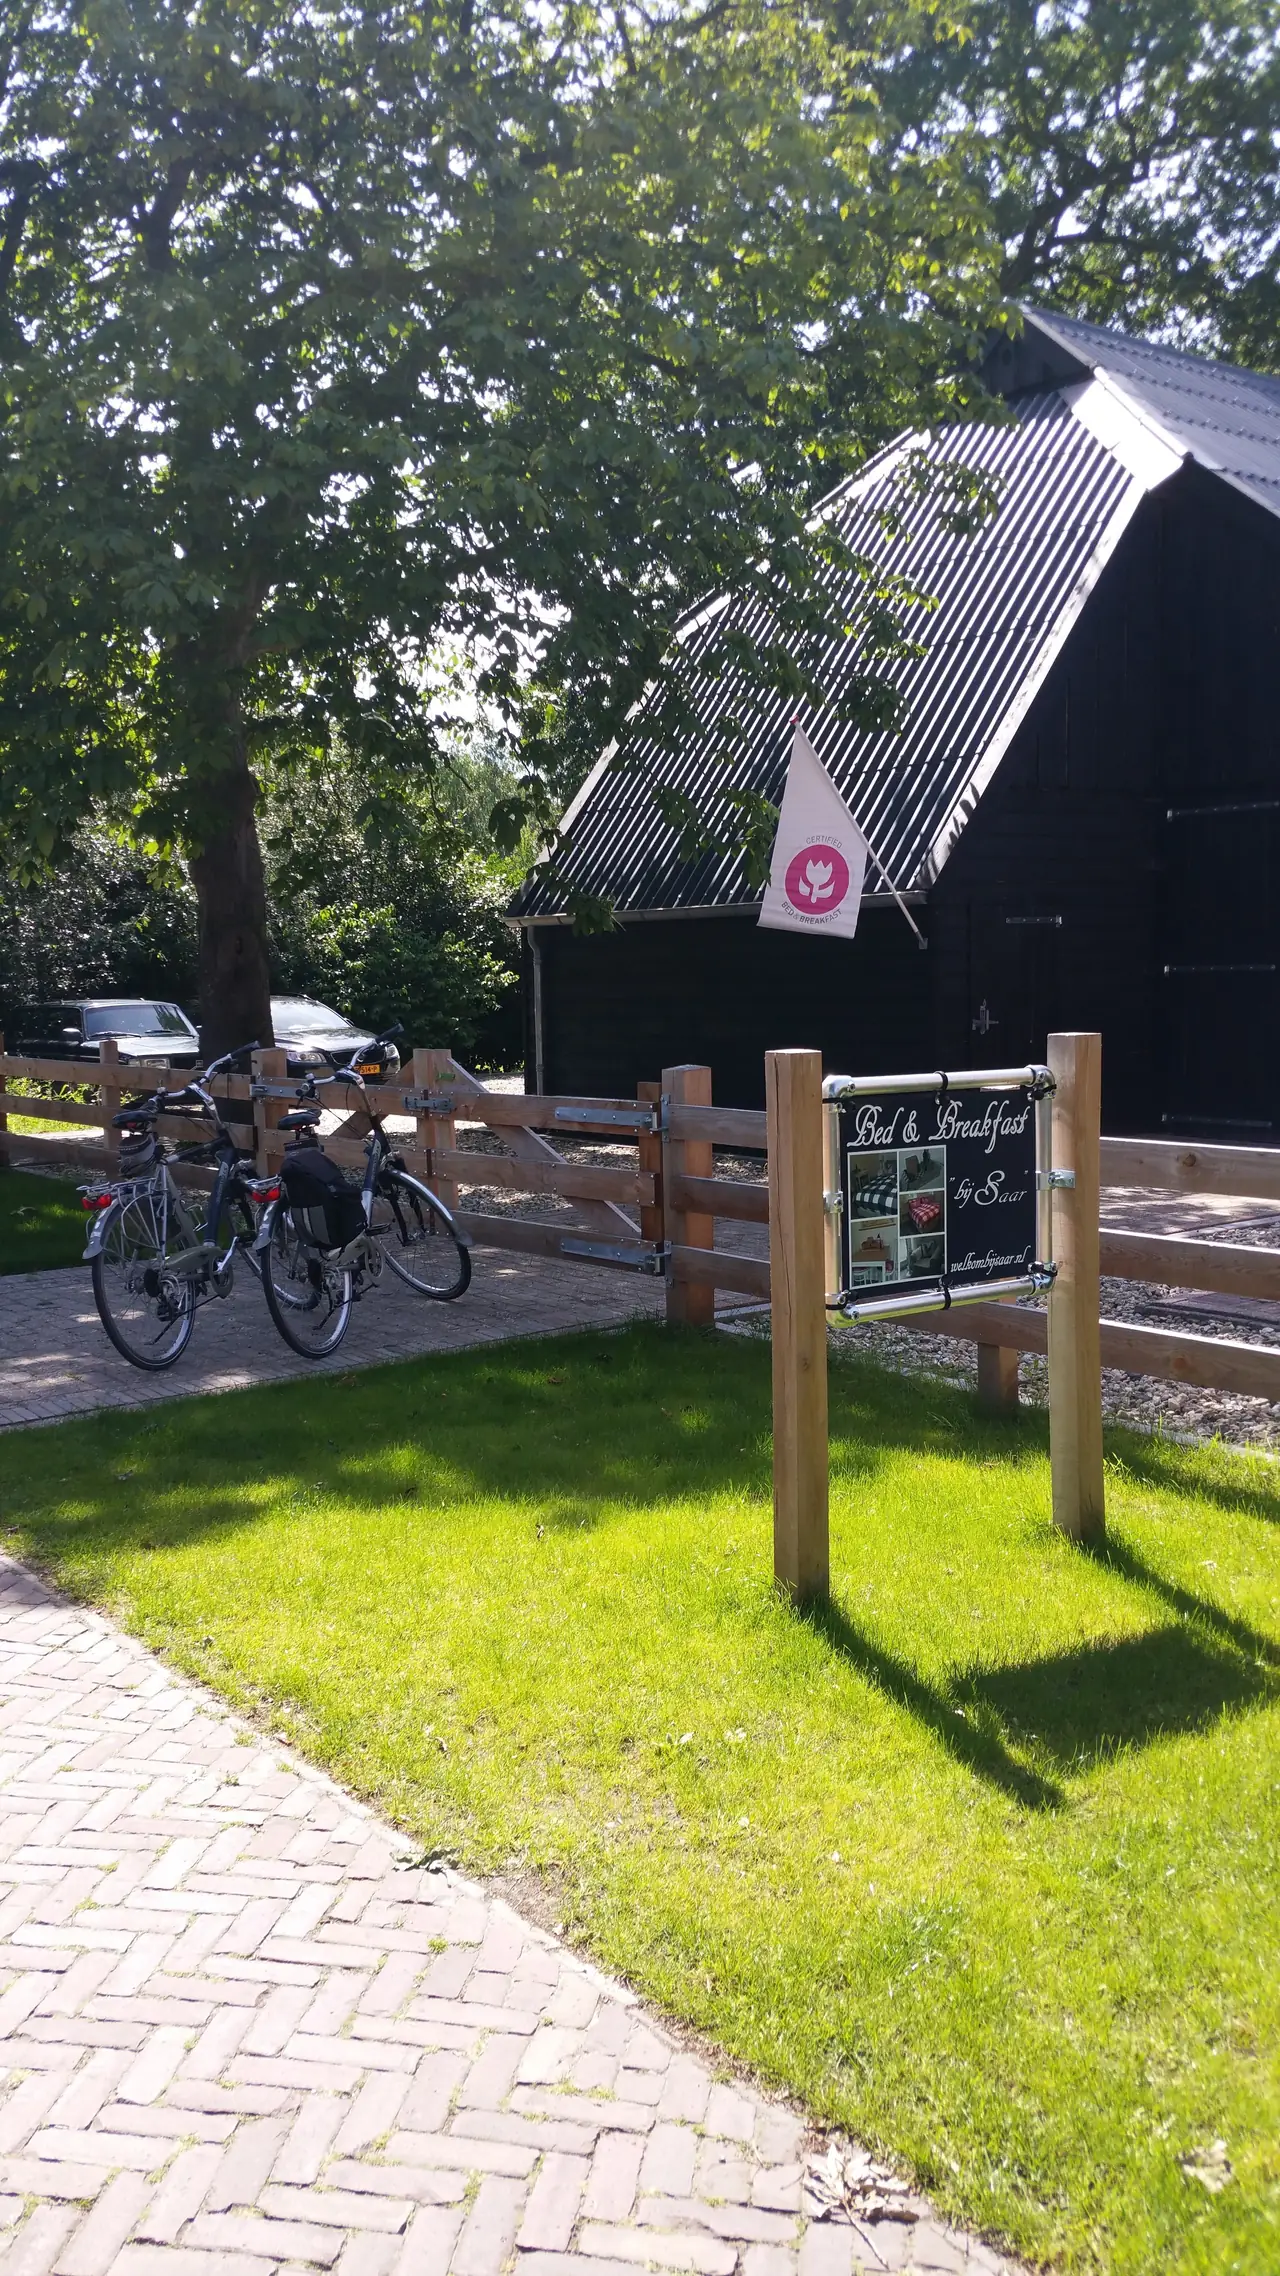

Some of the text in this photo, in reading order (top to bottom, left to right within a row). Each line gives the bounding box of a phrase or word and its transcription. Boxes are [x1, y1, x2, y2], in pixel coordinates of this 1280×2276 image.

[805, 835, 842, 849] CERTIFIED
[781, 901, 795, 917] BED
[799, 908, 842, 925] BREAKFAST
[846, 1100, 1031, 1154] Bed & Breakfast
[950, 1245, 1032, 1275] welkombijsaar.nl
